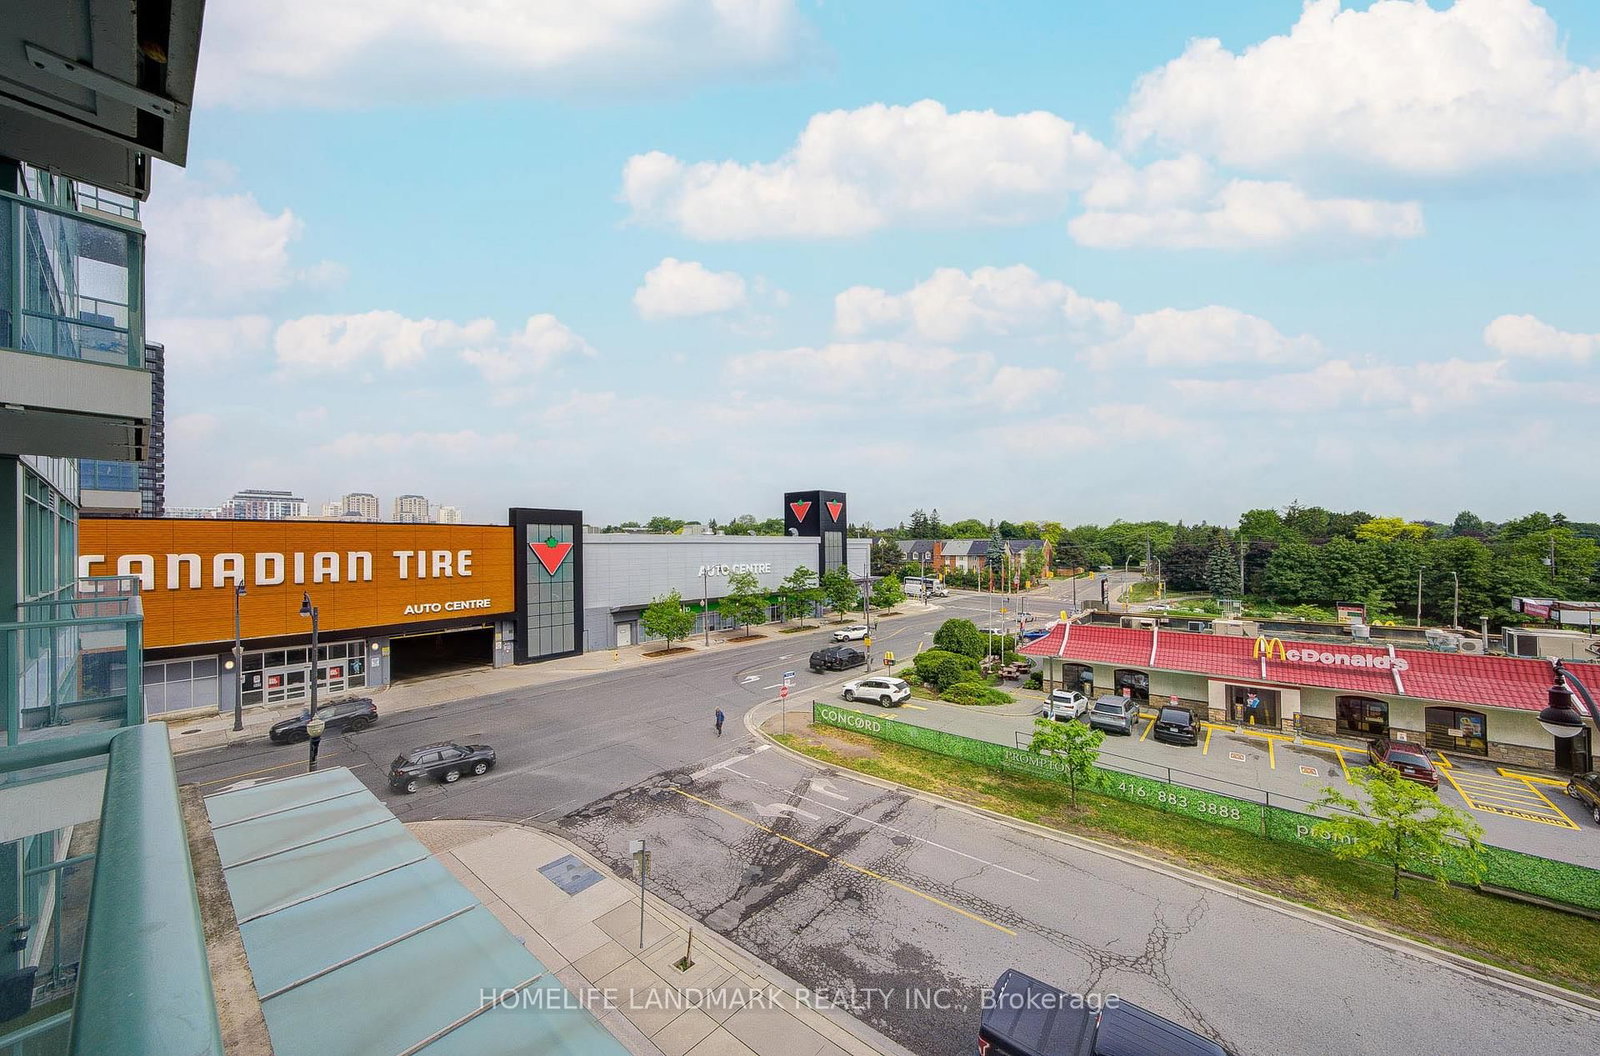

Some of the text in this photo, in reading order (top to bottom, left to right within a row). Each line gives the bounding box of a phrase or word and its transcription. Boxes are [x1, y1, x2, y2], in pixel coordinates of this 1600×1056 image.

[78, 550, 472, 592] CANADIAN TIRE
[698, 563, 771, 577] AUTO CENTRE
[404, 598, 491, 615] AUTO CENTRE
[1253, 637, 1409, 671] McDonald's
[1120, 782, 1240, 820] 416 883 3888
